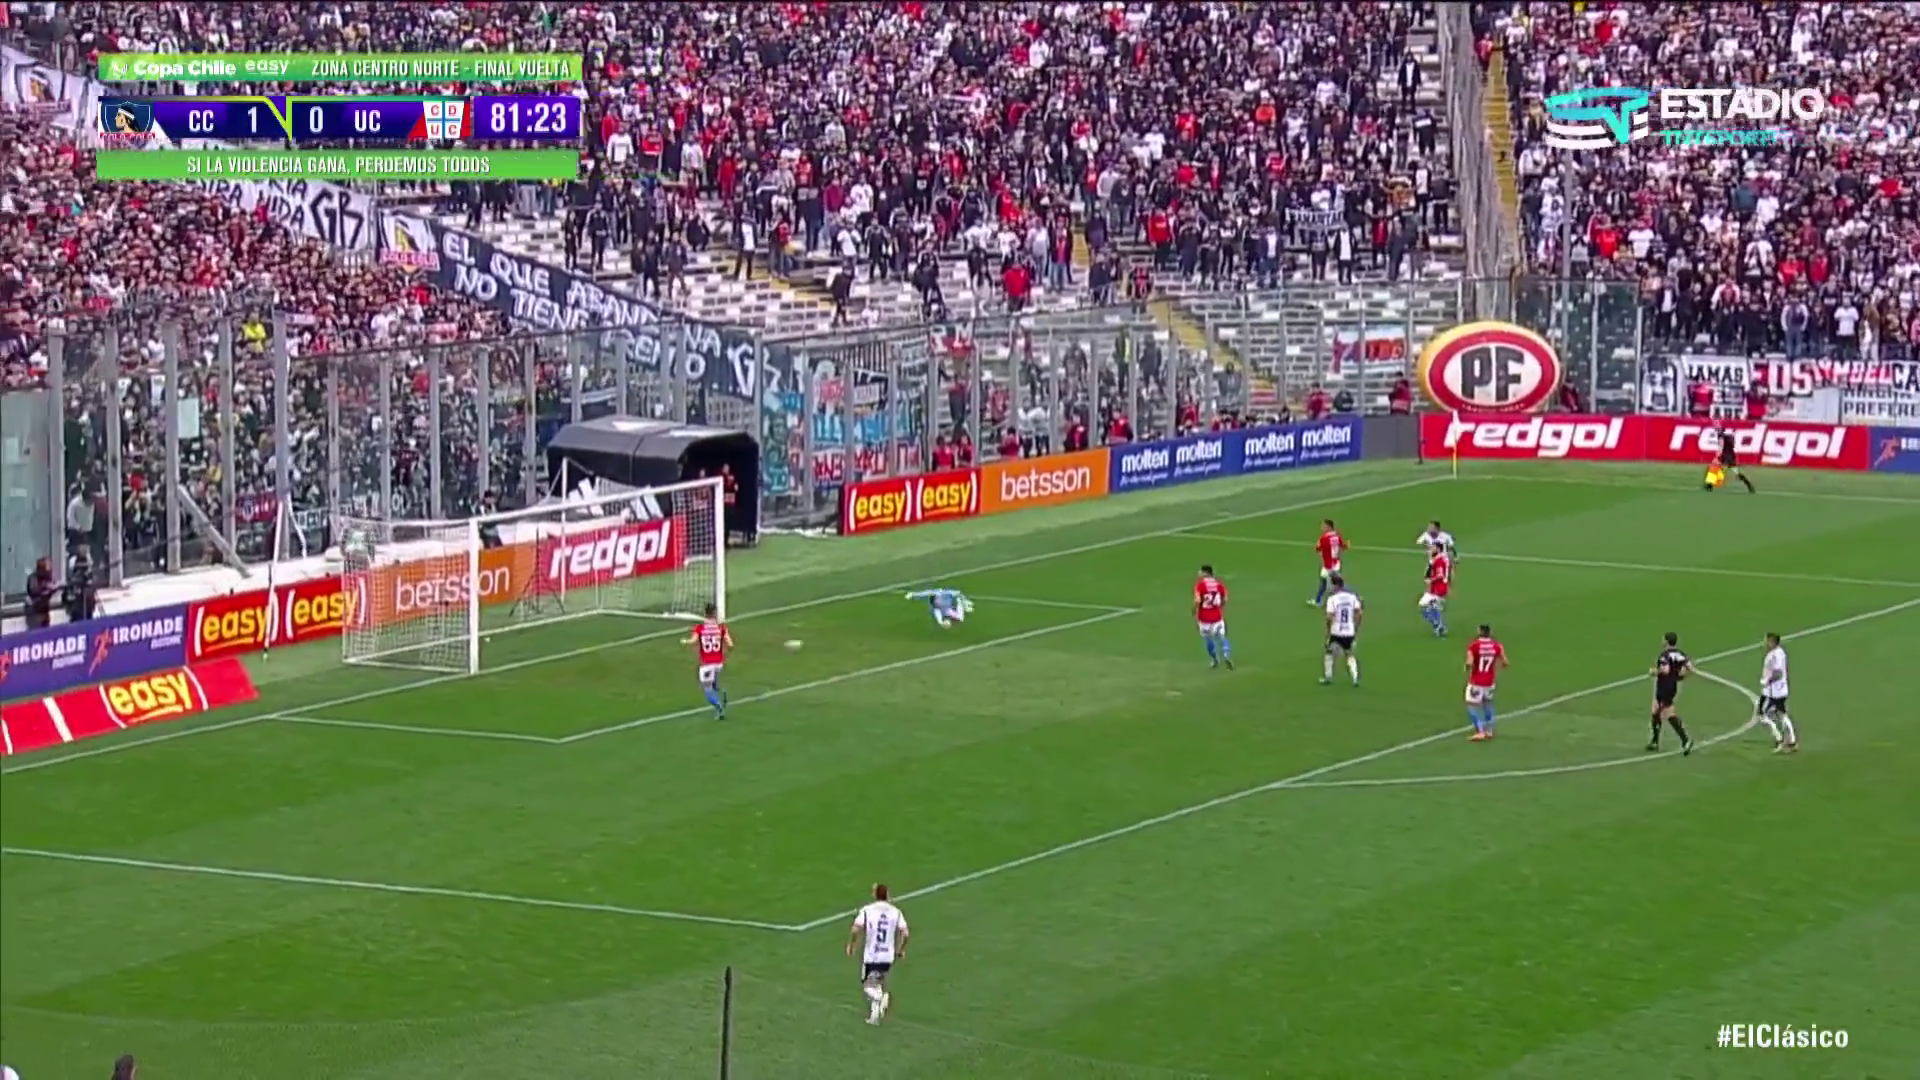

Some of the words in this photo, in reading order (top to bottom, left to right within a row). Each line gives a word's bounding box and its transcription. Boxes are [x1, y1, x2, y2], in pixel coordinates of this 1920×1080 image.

[442, 232, 476, 266] EL
[490, 251, 551, 296] QUE
[454, 265, 498, 301] NO
[1460, 345, 1525, 401] PF
[1175, 437, 1222, 463] molten
[1244, 431, 1295, 456] molten
[1302, 422, 1352, 448] molten
[1443, 416, 1625, 458] redgol
[1669, 423, 1847, 466] redgol
[1121, 447, 1170, 473] molten
[1000, 466, 1090, 501] betsson
[549, 520, 671, 578] redgol
[1202, 592, 1222, 609] 24
[112, 615, 184, 645] IRONADE
[12, 633, 87, 665] IRONADE
[1478, 656, 1495, 672] 17
[876, 920, 889, 943] 5
